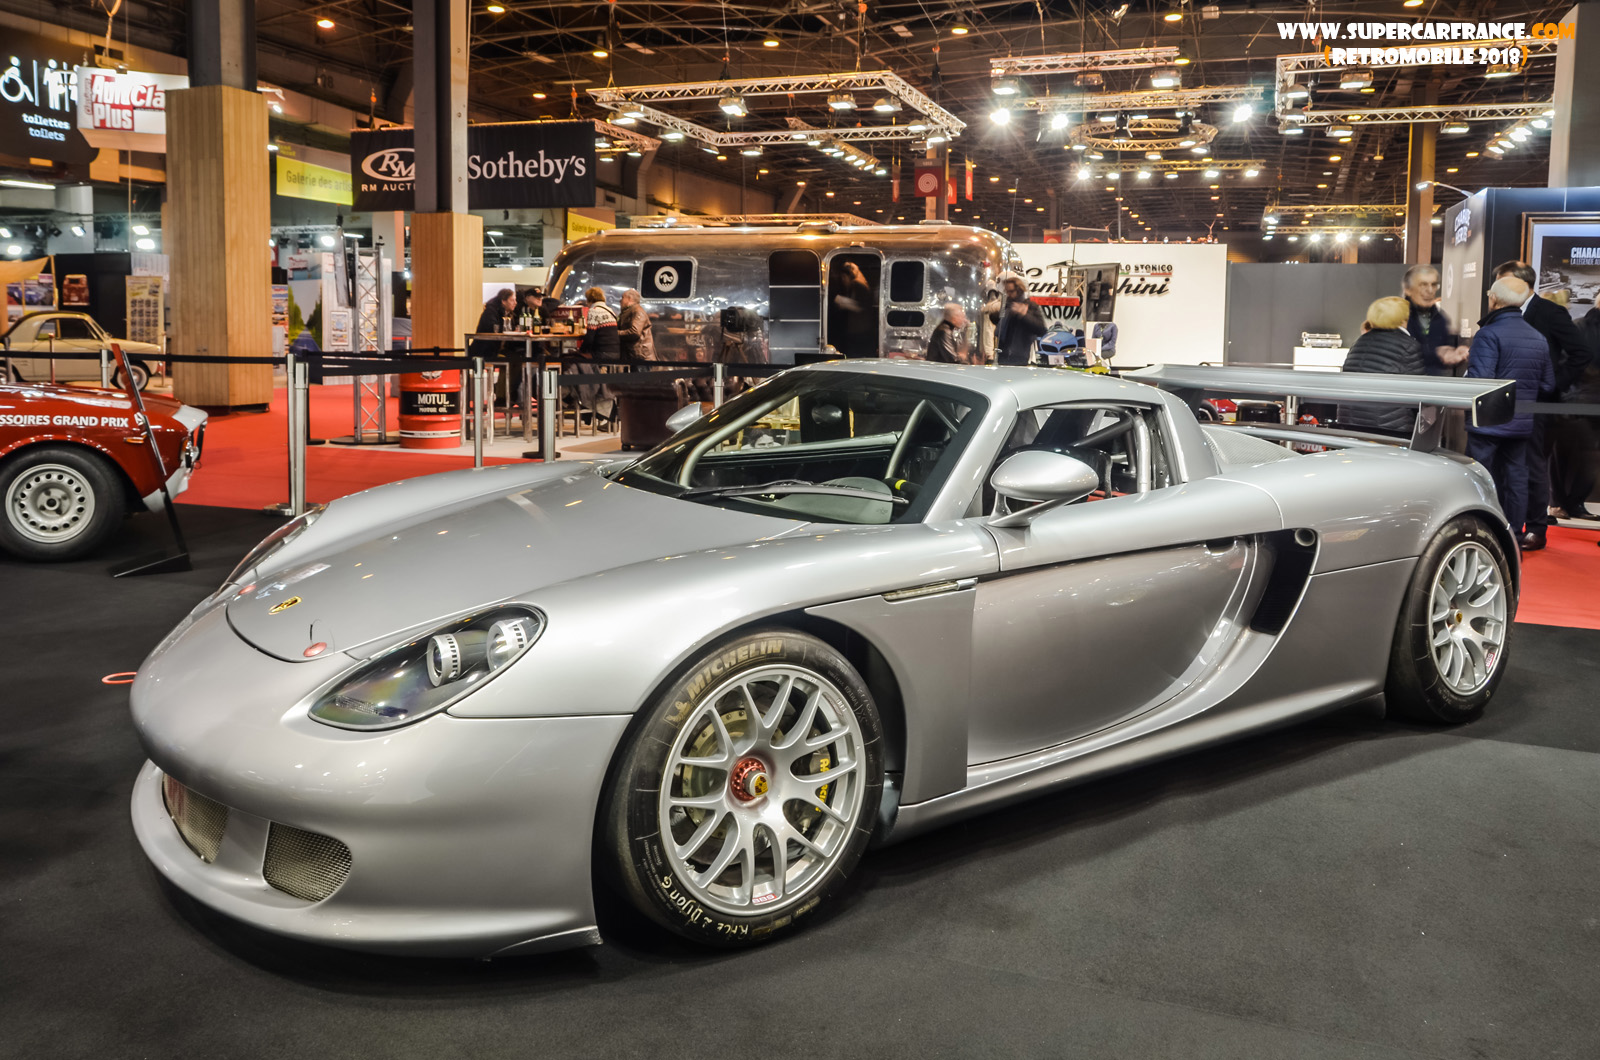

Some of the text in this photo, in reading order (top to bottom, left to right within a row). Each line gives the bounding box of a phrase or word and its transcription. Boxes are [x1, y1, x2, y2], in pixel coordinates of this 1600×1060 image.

[22, 113, 70, 130] toilettes
[92, 103, 133, 129] Plus
[28, 127, 66, 141] toilets
[378, 152, 415, 177] RM
[468, 150, 587, 183] Sotheby's
[286, 170, 317, 187] Galerie
[318, 177, 333, 189] des
[361, 183, 416, 192] RM AUCT
[417, 394, 450, 405] MOTUL
[0, 414, 129, 428] SSOIRES GRAND PRIX
[686, 639, 783, 701] MICHELIN
